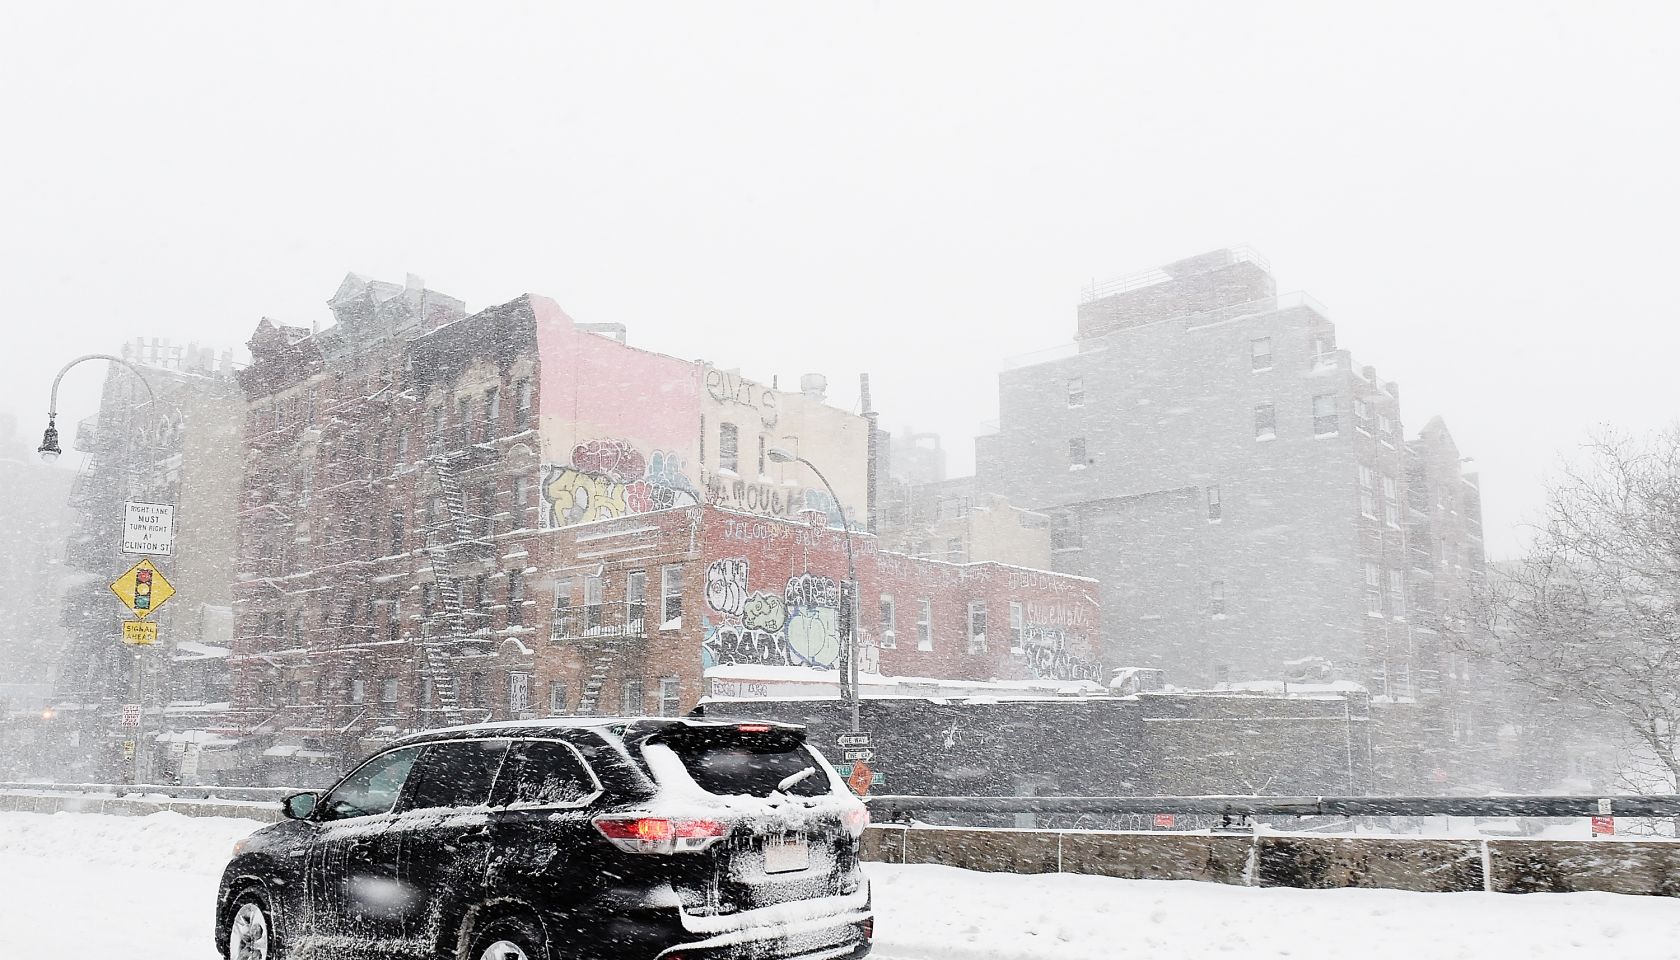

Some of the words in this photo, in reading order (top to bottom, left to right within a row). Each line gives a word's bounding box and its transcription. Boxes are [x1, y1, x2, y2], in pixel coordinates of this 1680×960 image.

[131, 505, 149, 513] RIGHT
[151, 507, 169, 516] LANE
[138, 515, 159, 523] MUST
[130, 523, 147, 531] TURN
[149, 525, 167, 533] RIGHT
[124, 541, 158, 550] CLINTON
[160, 543, 170, 552] ST
[126, 625, 154, 633] SIGNAL
